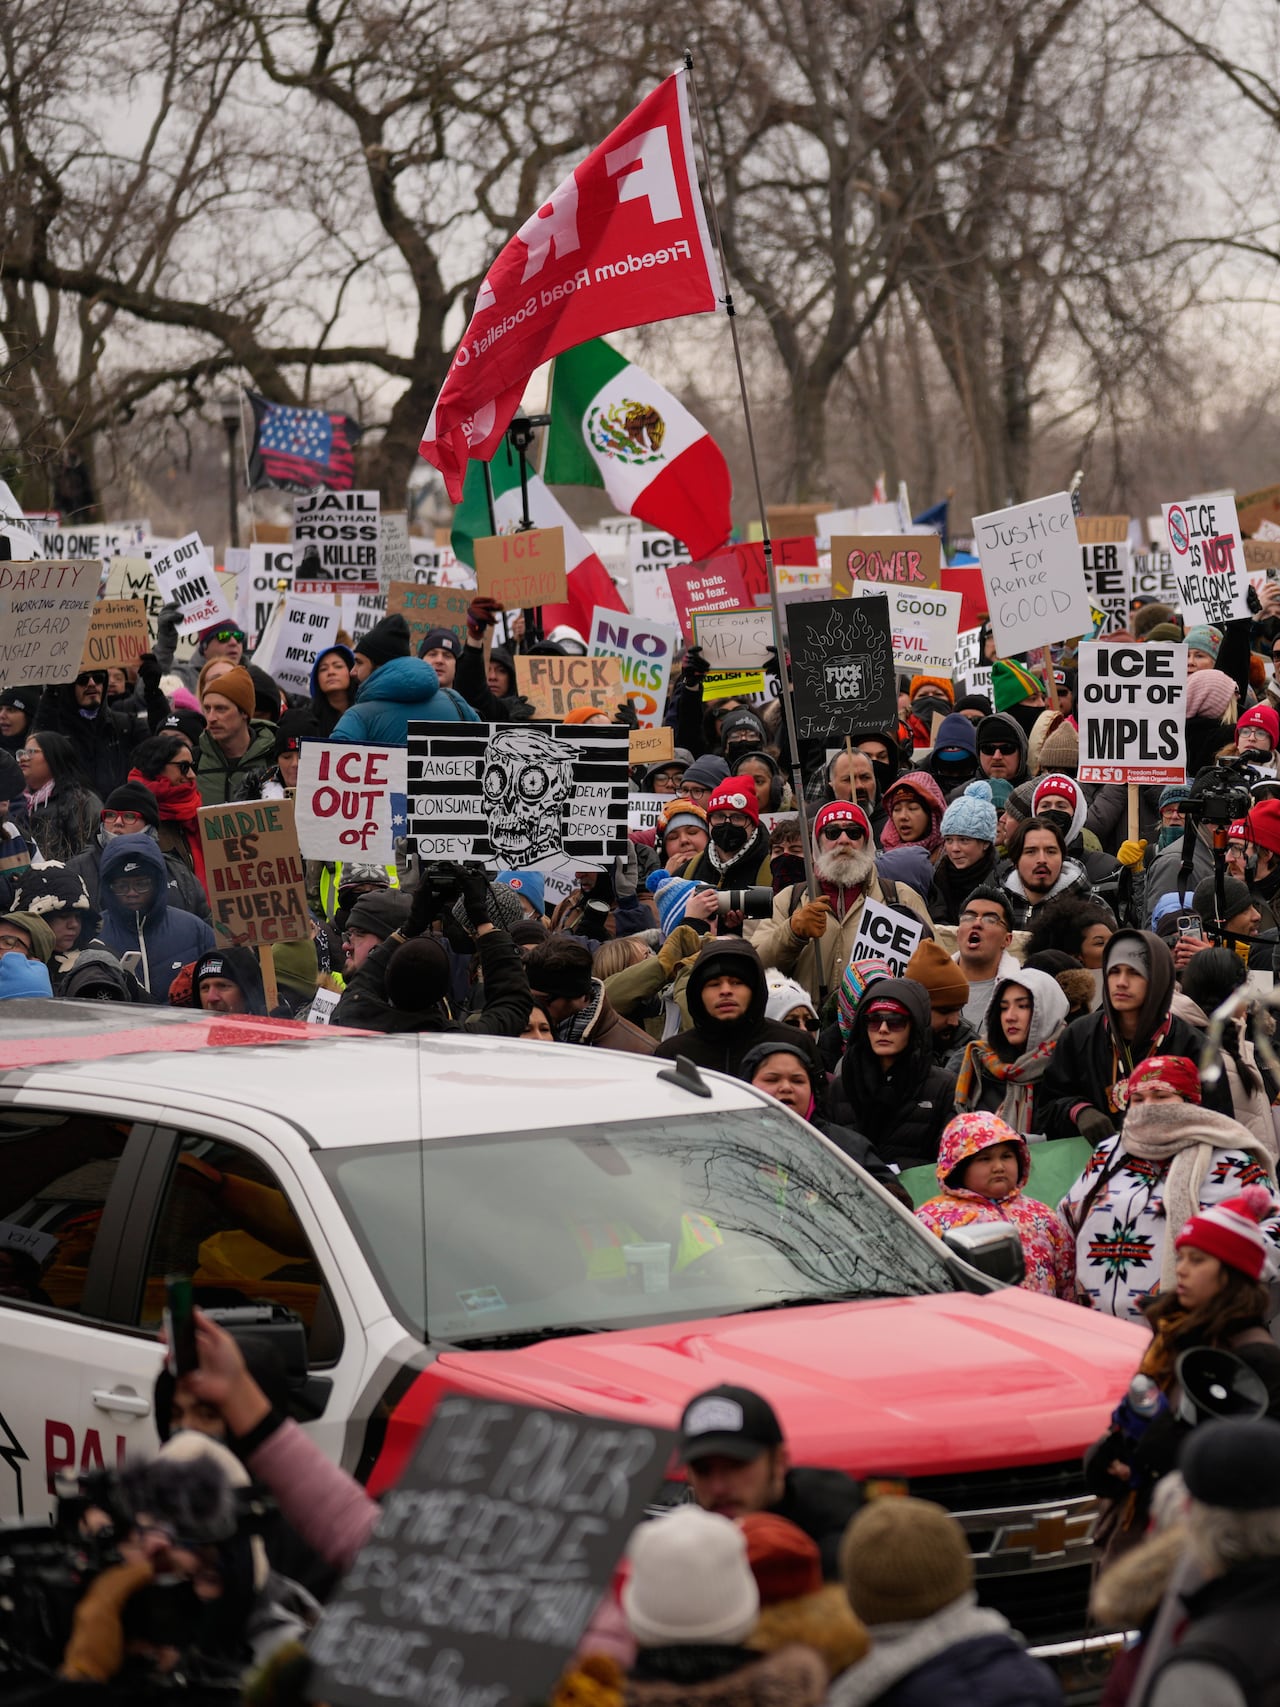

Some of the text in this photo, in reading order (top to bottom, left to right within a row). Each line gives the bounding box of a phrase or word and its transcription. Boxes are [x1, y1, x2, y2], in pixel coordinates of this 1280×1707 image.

[297, 494, 377, 513] JAIL
[296, 514, 376, 523] JONATHAN
[1185, 505, 1219, 538] ICE
[296, 525, 378, 541] ROSS
[982, 512, 1069, 550] Justice
[44, 534, 64, 555] NO
[67, 534, 99, 556] ONE
[502, 533, 541, 563] ICE
[642, 539, 690, 559] ICE
[1189, 534, 1237, 575] IS NOT
[154, 540, 201, 577] ICE OUT
[324, 545, 377, 566] KILLER
[1009, 549, 1044, 572] For
[176, 567, 188, 580] OF
[334, 568, 377, 581] ICE
[848, 549, 928, 583] POWER
[171, 576, 210, 606] MN!
[490, 573, 557, 600] GESTAPO
[686, 575, 727, 592] No hate.
[990, 571, 1048, 597] Renee
[1132, 574, 1177, 593] ICE
[1177, 572, 1240, 607] WELCOME
[402, 591, 438, 609] ICE
[691, 587, 728, 602] No fear.
[11, 599, 89, 614] WORKING PEOPLE
[106, 603, 139, 614] drinks,
[184, 605, 220, 625] MIRAC
[896, 599, 947, 617] GOOD
[1000, 590, 1072, 629] GOOD
[1203, 600, 1235, 623] HERE
[14, 617, 70, 638] REGARD
[88, 618, 144, 632] ommunities
[289, 609, 306, 625] ICE
[308, 613, 330, 629] OUT
[700, 614, 767, 629] ICE out of
[302, 632, 314, 644] OF
[597, 620, 668, 659] NO
[701, 631, 771, 661] MPLS
[892, 635, 928, 652] EVIL
[51, 640, 69, 657] OR
[89, 635, 148, 662] OUT NOW
[904, 653, 922, 664] OUR
[924, 655, 952, 667] CITIES
[1097, 648, 1174, 679] ICE
[21, 664, 72, 679] STATUS
[278, 672, 309, 687] MIRA
[529, 659, 610, 688] FUCK
[825, 664, 863, 683] FUCK
[972, 671, 993, 687] JUS
[552, 688, 607, 716] ICE
[1084, 684, 1183, 704] OUT OF
[800, 714, 896, 739] Fuck Trump!
[1087, 718, 1180, 761] MPLS
[318, 751, 389, 785] ICE
[424, 760, 476, 777] ANGER
[576, 785, 612, 799] DELAY
[312, 786, 384, 820] OUT
[416, 798, 481, 816] CONSUME
[572, 802, 607, 817] DENY
[628, 800, 665, 812] GALIZA
[204, 805, 283, 840] NADIE
[568, 822, 616, 838] DEPOSE
[339, 822, 379, 851] of
[420, 837, 472, 854] OBEY
[223, 834, 260, 862] ES
[213, 856, 304, 892] ILEGAL
[217, 888, 304, 924] FUERA
[247, 915, 308, 941] ICE!
[860, 908, 916, 957] ICE
